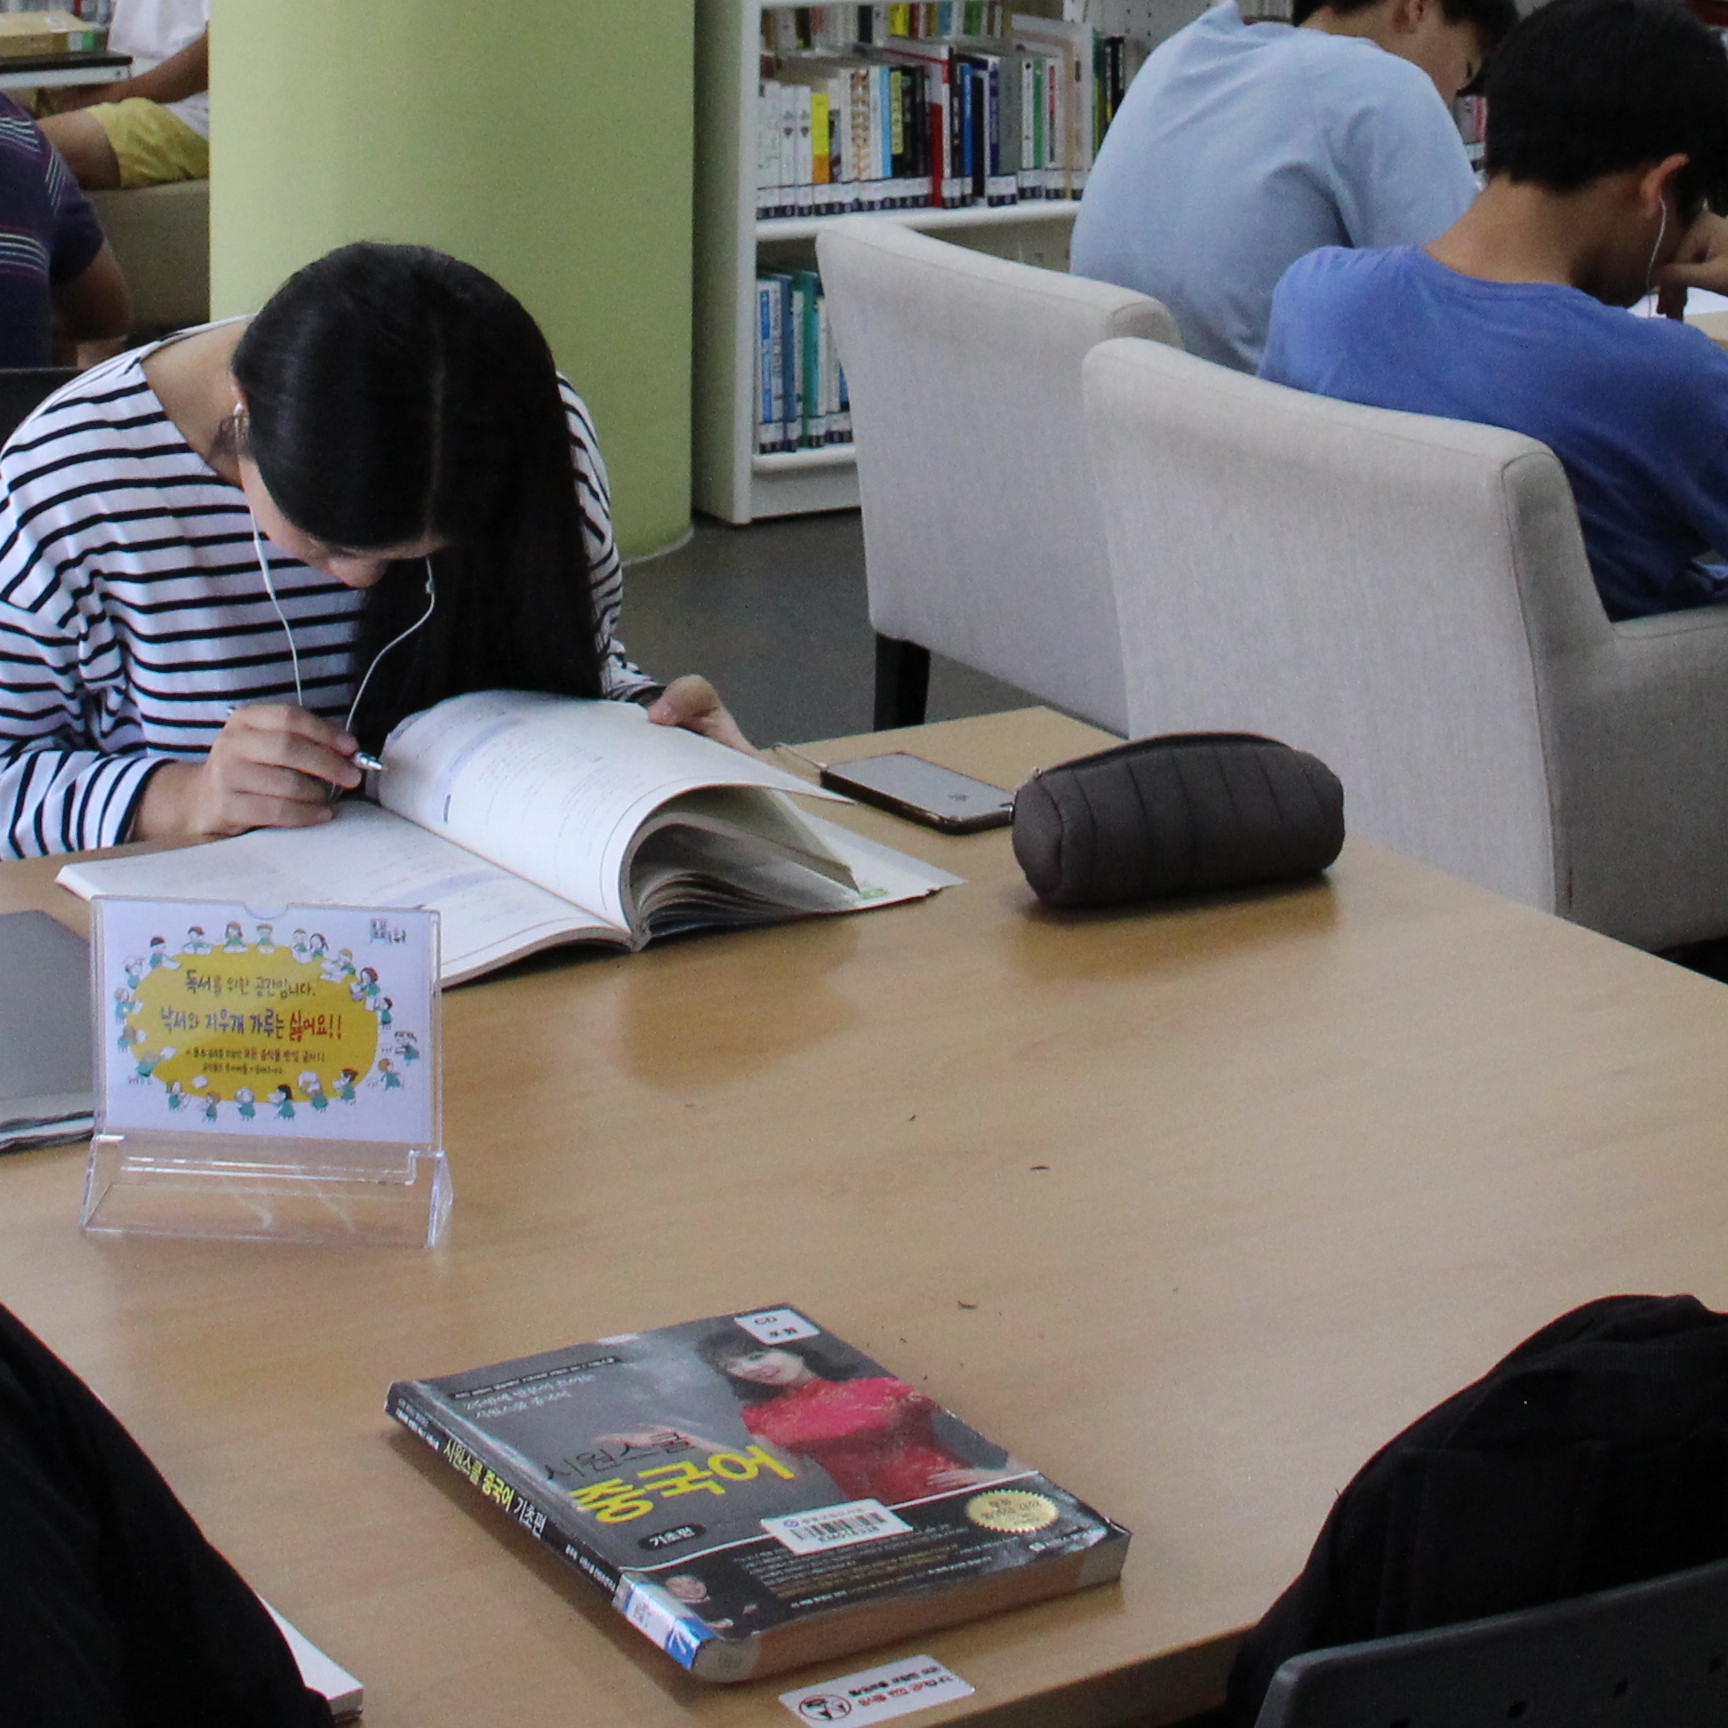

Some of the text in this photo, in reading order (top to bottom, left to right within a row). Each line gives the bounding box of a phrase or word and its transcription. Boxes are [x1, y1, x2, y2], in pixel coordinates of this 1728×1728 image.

[185, 969, 316, 999] 독서를 위한 공간입니다.
[161, 1005, 342, 1042] 낙서와 지우개 가루는 싫어요!!
[754, 1316, 777, 1325] CD
[546, 1432, 696, 1480] 시원스쿨
[443, 1439, 547, 1539] 시원스쿨 중국어 기초편
[569, 1445, 795, 1524] 중국어
[649, 1526, 697, 1547] 기초편
